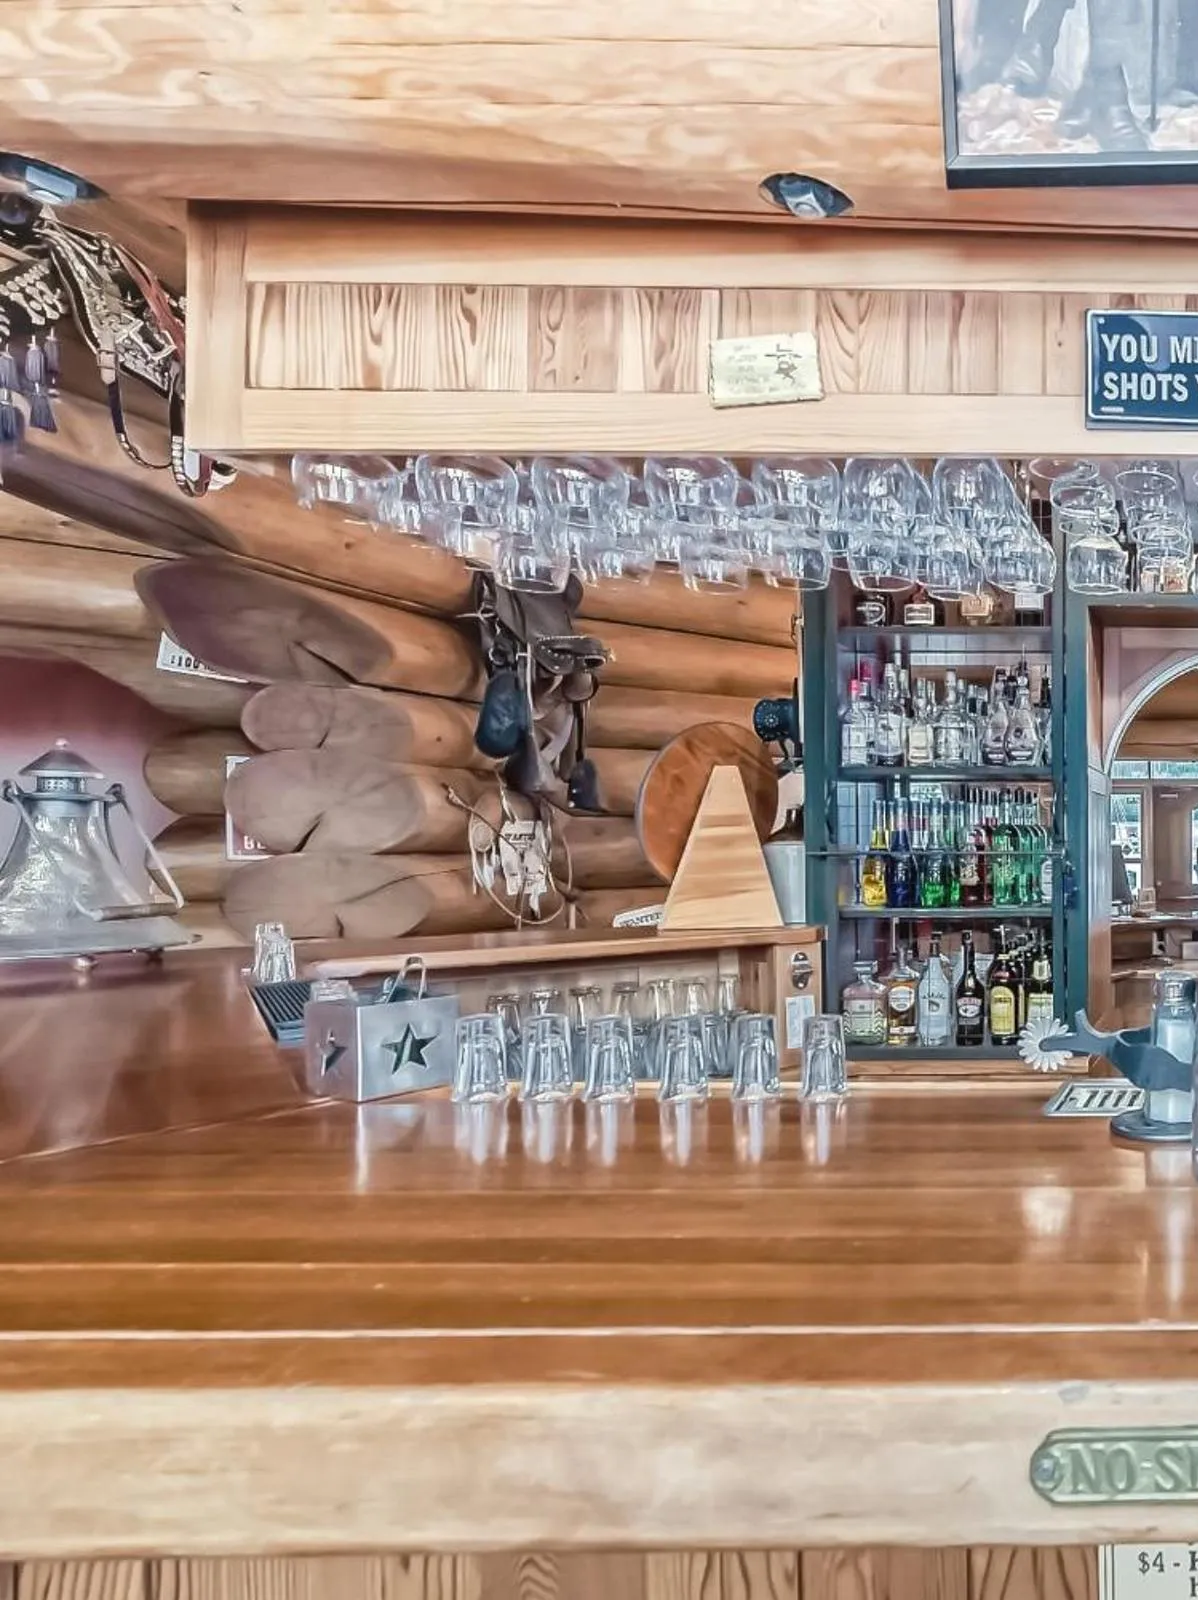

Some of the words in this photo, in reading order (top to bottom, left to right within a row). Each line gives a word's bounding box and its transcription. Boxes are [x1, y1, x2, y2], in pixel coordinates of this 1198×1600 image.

[1101, 333, 1158, 363] YOU
[1103, 372, 1188, 402] SHOTS
[1138, 1551, 1165, 1574] $4
